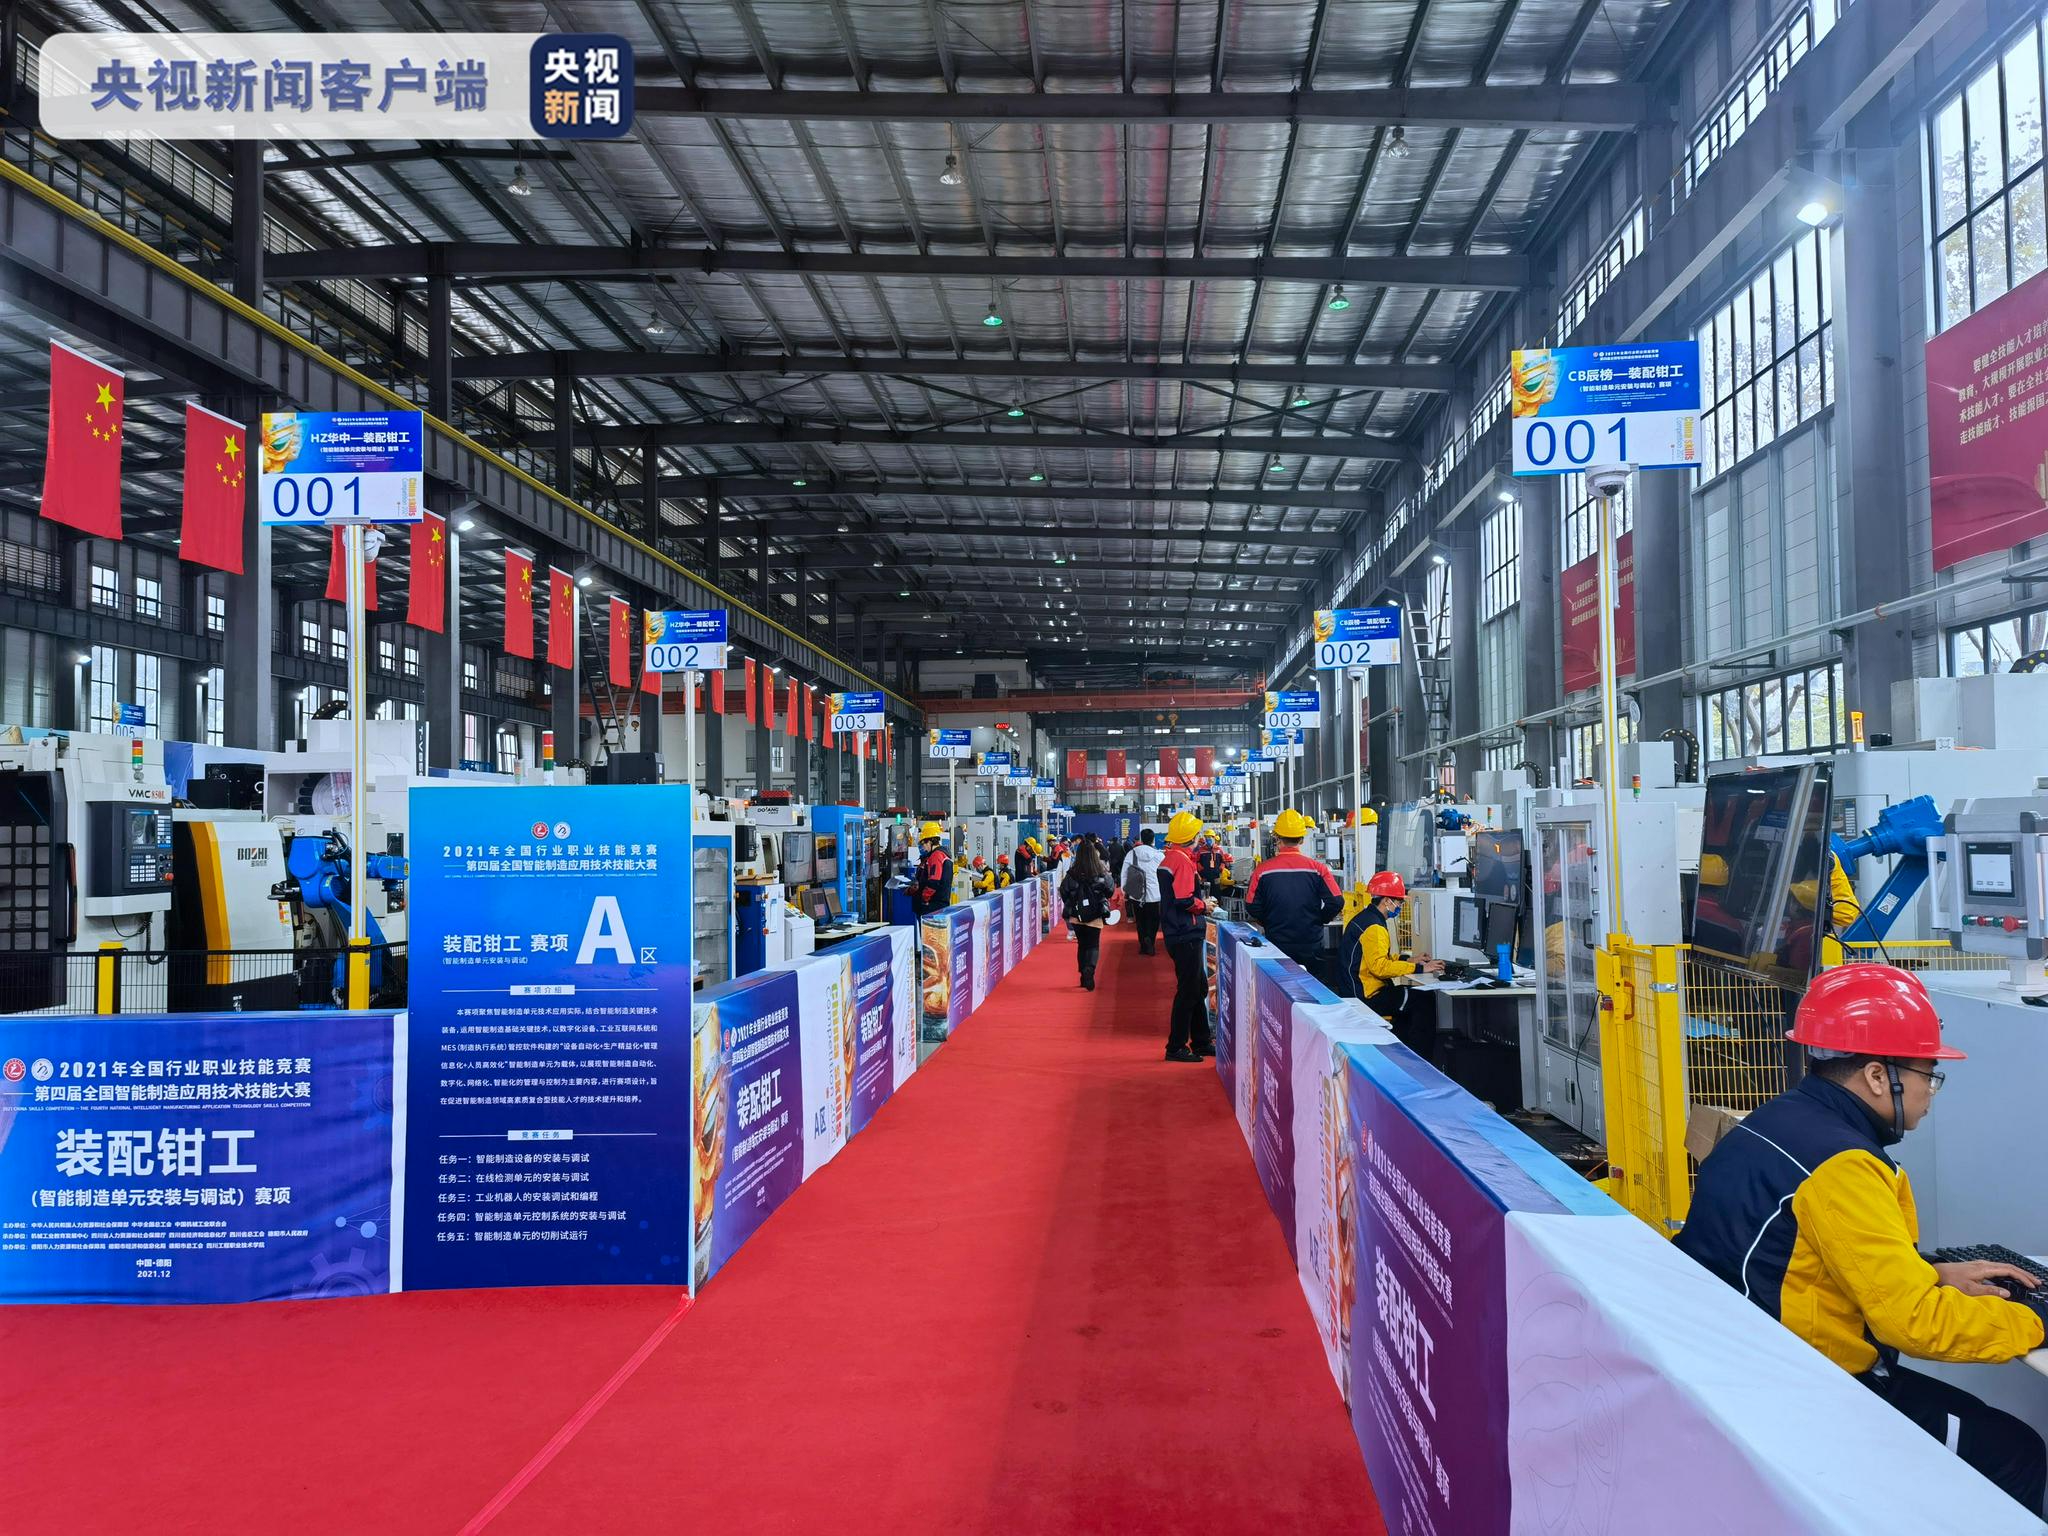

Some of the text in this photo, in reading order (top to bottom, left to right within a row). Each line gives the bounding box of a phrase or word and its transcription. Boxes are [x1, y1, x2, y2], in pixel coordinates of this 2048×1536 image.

[1526, 416, 1627, 466] 001
[273, 476, 360, 517] 001
[651, 645, 699, 668] 002
[1321, 642, 1371, 666] 002
[834, 715, 866, 729] 003
[1269, 713, 1302, 728] 003
[932, 745, 956, 757] 001
[1265, 745, 1290, 757] 004
[979, 765, 999, 775] 002
[1242, 762, 1261, 772] 001
[1221, 776, 1238, 784] 002
[443, 844, 657, 858] 2021年全国行业职业技能竞赛
[466, 859, 657, 872] 第四届全国智能制造应用技术技能大赛
[443, 934, 521, 954] 装配钳工
[531, 934, 569, 953] 赛项
[59, 1057, 311, 1078] 2021年全国行业职业技能竞赛
[34, 1081, 311, 1102] 第四届全国智能制造应用技术技能大赛
[736, 1068, 782, 1131] 装配钳工
[814, 1105, 827, 1140] A区
[521, 1131, 560, 1139] 竞赛任务
[55, 1127, 257, 1177] 装配钳工
[438, 1153, 590, 1165] 任务一：智能制造设备的安装与调试
[438, 1172, 589, 1184] 任务二：在线检测单元的安装与调试
[31, 1186, 291, 1208] （智能制造单元安装与调试） 赛项
[438, 1191, 599, 1203] 任务三：工业机器人的安装调试和编程
[437, 1210, 627, 1222] 任务四：智能制造单元控制系统的安装与调试
[436, 1230, 588, 1242] 任务五：智能制造单元的切削试运行
[137, 1270, 171, 1278] 2021.12
[1375, 1245, 1436, 1422] 装配钳工
